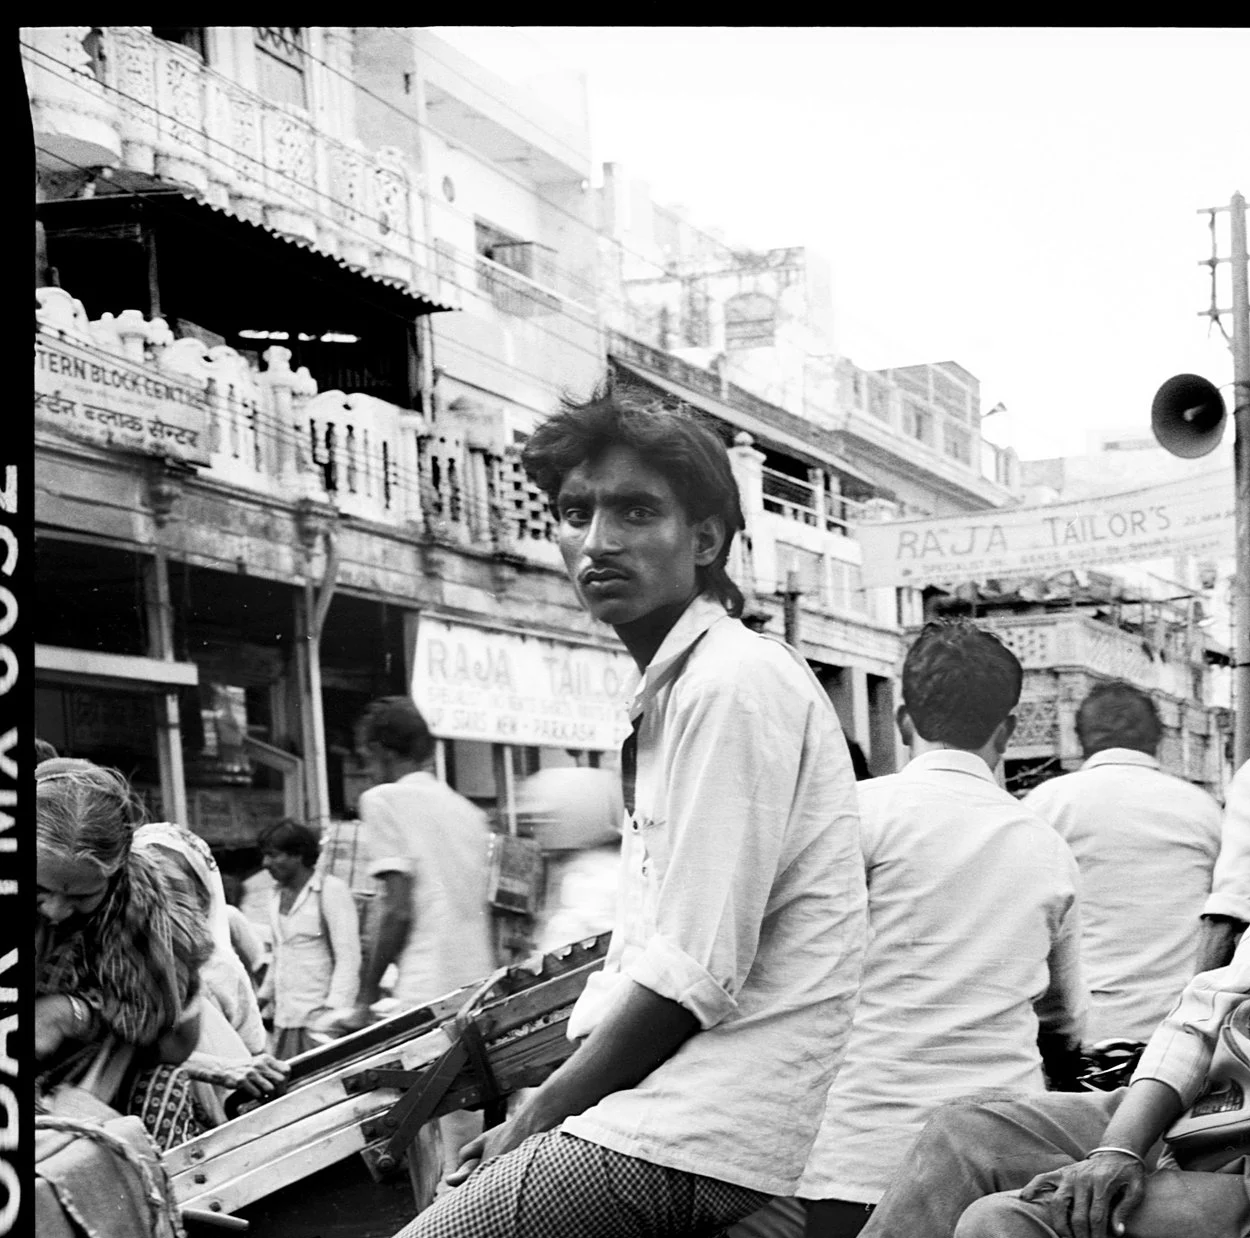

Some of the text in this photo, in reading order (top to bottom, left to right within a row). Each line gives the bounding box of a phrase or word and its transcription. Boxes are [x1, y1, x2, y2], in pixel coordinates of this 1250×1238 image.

[91, 364, 145, 395] BLOCK
[897, 524, 1009, 560] RAJA
[1042, 506, 1171, 547] TAILOR'S
[427, 637, 515, 688] RAJA
